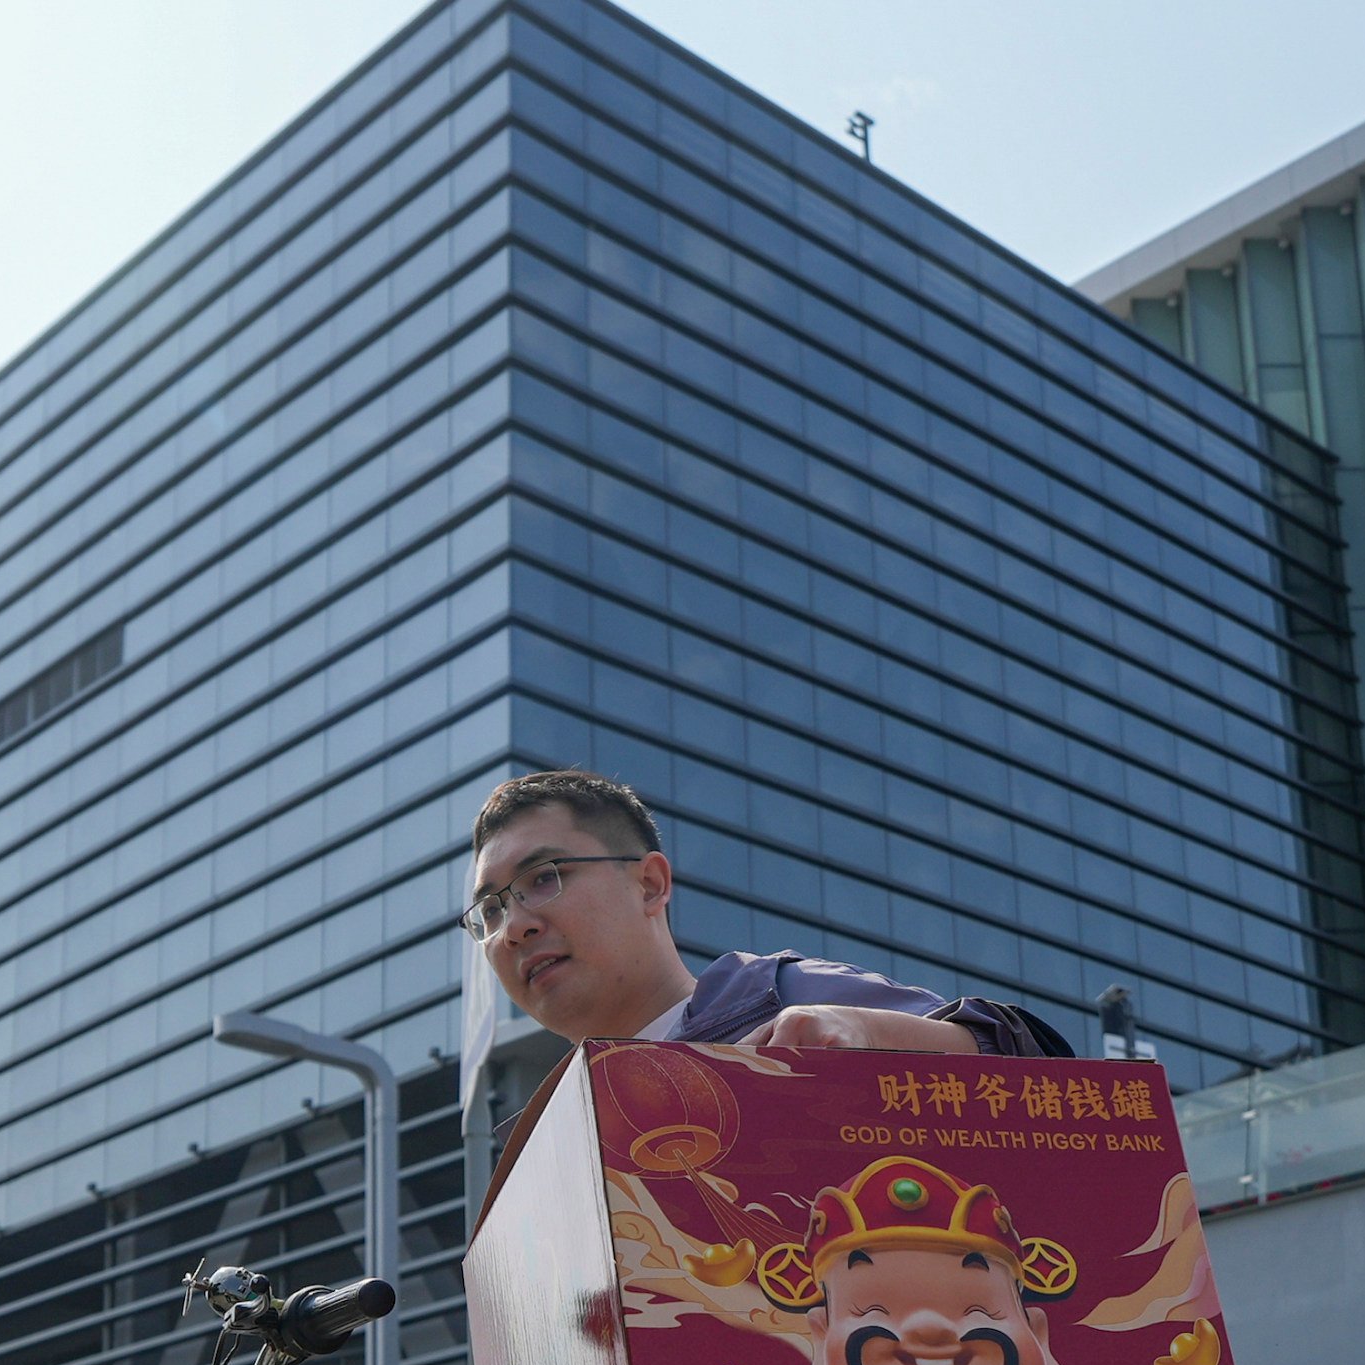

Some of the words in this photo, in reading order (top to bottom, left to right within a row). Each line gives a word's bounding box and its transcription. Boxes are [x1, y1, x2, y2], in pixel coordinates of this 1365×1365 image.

[876, 1070, 1158, 1122] 财神爷储钱罐
[839, 1125, 892, 1145] GOD
[899, 1127, 929, 1146] OF
[934, 1129, 1026, 1150] WEALTH
[1034, 1132, 1098, 1151] PIGGY
[1107, 1134, 1166, 1153] BANK
